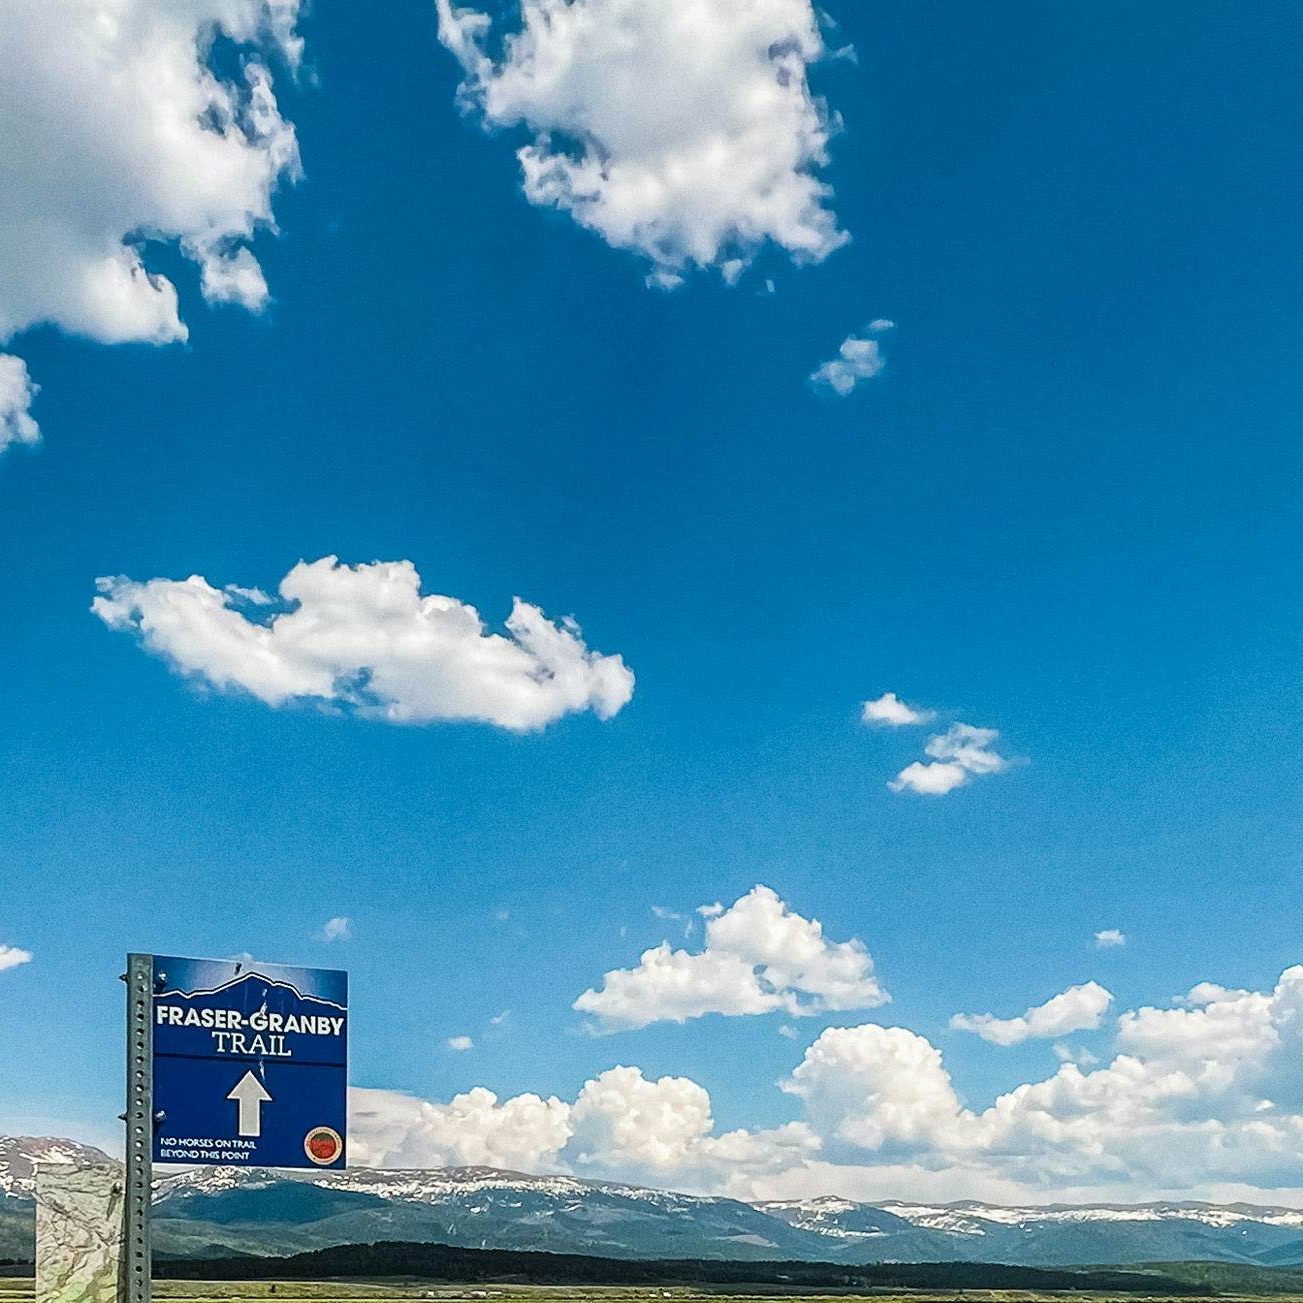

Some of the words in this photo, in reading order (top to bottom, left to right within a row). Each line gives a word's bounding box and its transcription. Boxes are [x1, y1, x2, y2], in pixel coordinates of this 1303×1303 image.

[156, 1005, 345, 1036] FRASER-GRANBY
[211, 1031, 293, 1057] TRAIL
[160, 1137, 177, 1146] NO
[178, 1138, 214, 1148] HORSES
[214, 1139, 231, 1148] ON
[231, 1140, 257, 1150] TRAIL
[160, 1148, 199, 1159] BEYOND
[199, 1150, 220, 1160] THIS
[221, 1151, 250, 1160] POINT
